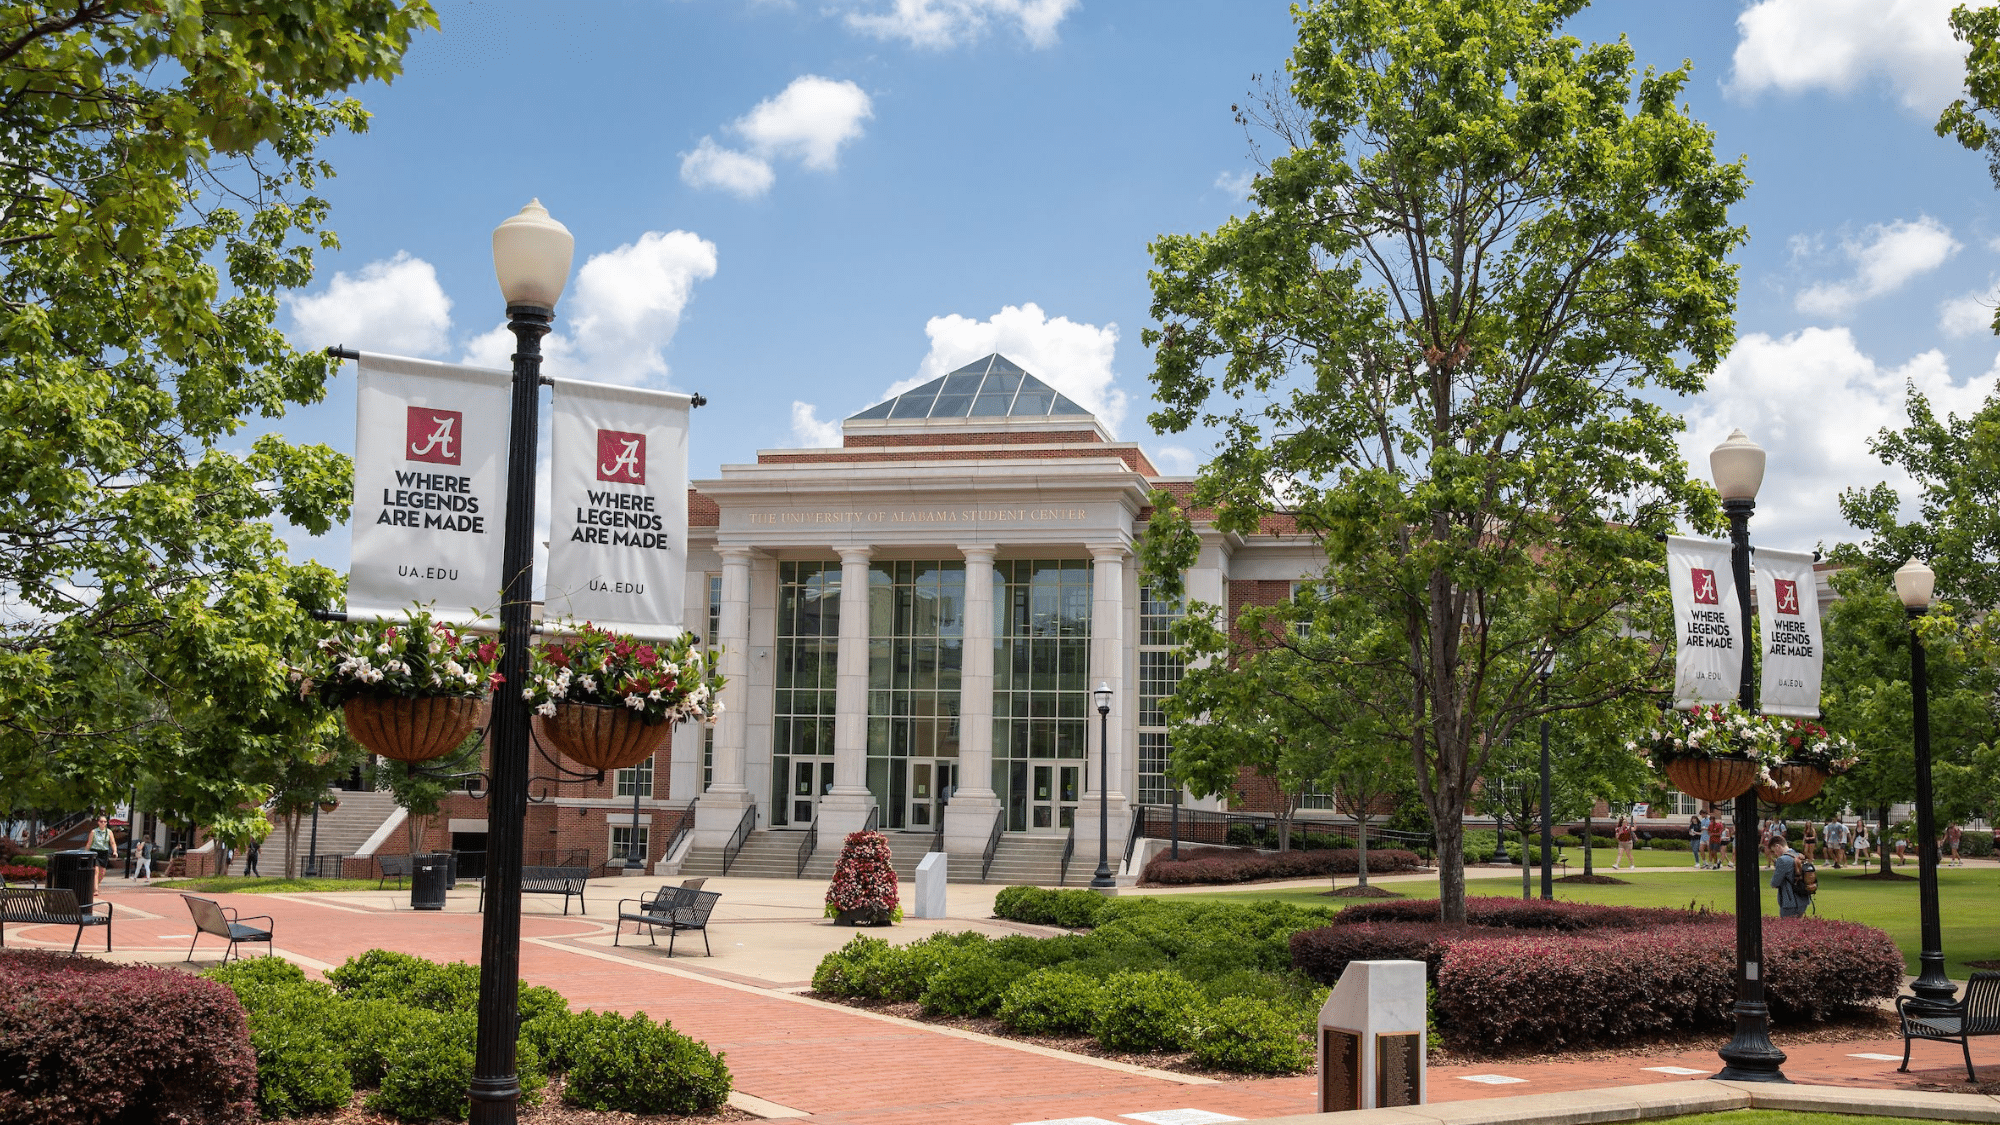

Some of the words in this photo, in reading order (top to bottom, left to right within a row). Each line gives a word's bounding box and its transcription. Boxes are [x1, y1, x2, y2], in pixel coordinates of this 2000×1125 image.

[411, 416, 456, 459] A
[601, 438, 641, 478] A
[395, 470, 471, 494] WHERE
[383, 488, 479, 514] LEGENDS
[587, 489, 655, 513] WHERE
[377, 508, 420, 528] ARE
[577, 507, 663, 532] LEGENDS
[749, 513, 777, 524] THE
[781, 511, 863, 524] UNIVERSITY
[867, 511, 886, 522] OF
[891, 510, 957, 522] ALABAMA
[962, 509, 1027, 521] STUDENT
[1030, 509, 1087, 520] CENTER
[571, 526, 609, 545] ARE
[398, 565, 459, 581] UA.EDU
[589, 580, 644, 595] UA.EDU
[1696, 573, 1717, 601] A
[1778, 584, 1797, 611] A
[1691, 610, 1725, 623] WHERE
[1687, 622, 1730, 636] LEGENDS
[1774, 620, 1806, 633] WHERE
[1686, 636, 1704, 647] ARE
[1771, 631, 1811, 645] LEGENDS
[1769, 644, 1787, 656] ARE
[1696, 671, 1722, 681] UA.EDU
[1778, 679, 1803, 688] UA.EDU
